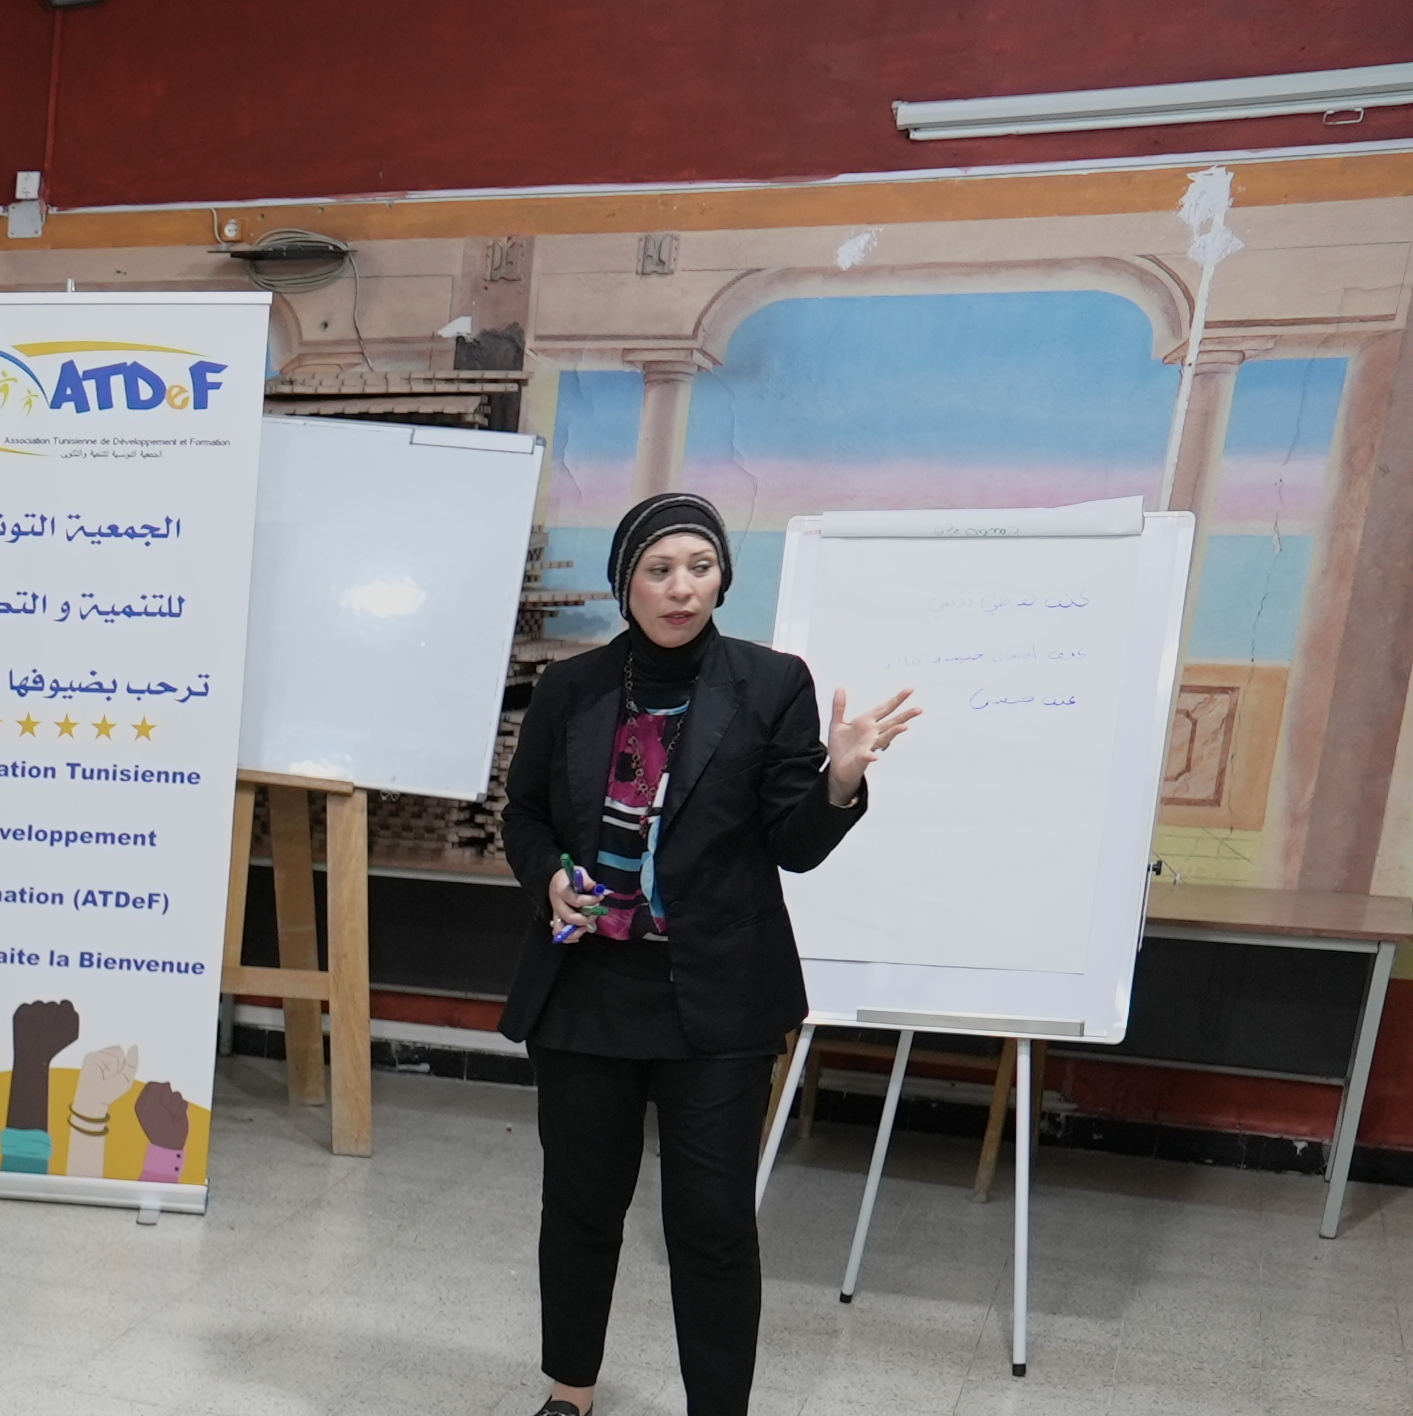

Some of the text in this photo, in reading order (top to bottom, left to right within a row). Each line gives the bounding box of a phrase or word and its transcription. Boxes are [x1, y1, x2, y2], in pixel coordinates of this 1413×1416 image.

[49, 359, 229, 415] ATDeF
[4, 436, 231, 449] Association Tunisienne de Développement et Formation
[66, 514, 181, 548] الجمعية
[53, 601, 71, 623] و
[79, 593, 186, 624] للتنمية
[9, 668, 118, 702] بضيوفها
[126, 674, 210, 703] ترحب
[66, 761, 201, 786] Tunisienne
[72, 888, 170, 916] (ATDeF)
[48, 949, 70, 968] la
[78, 950, 206, 976] Bienvenue
